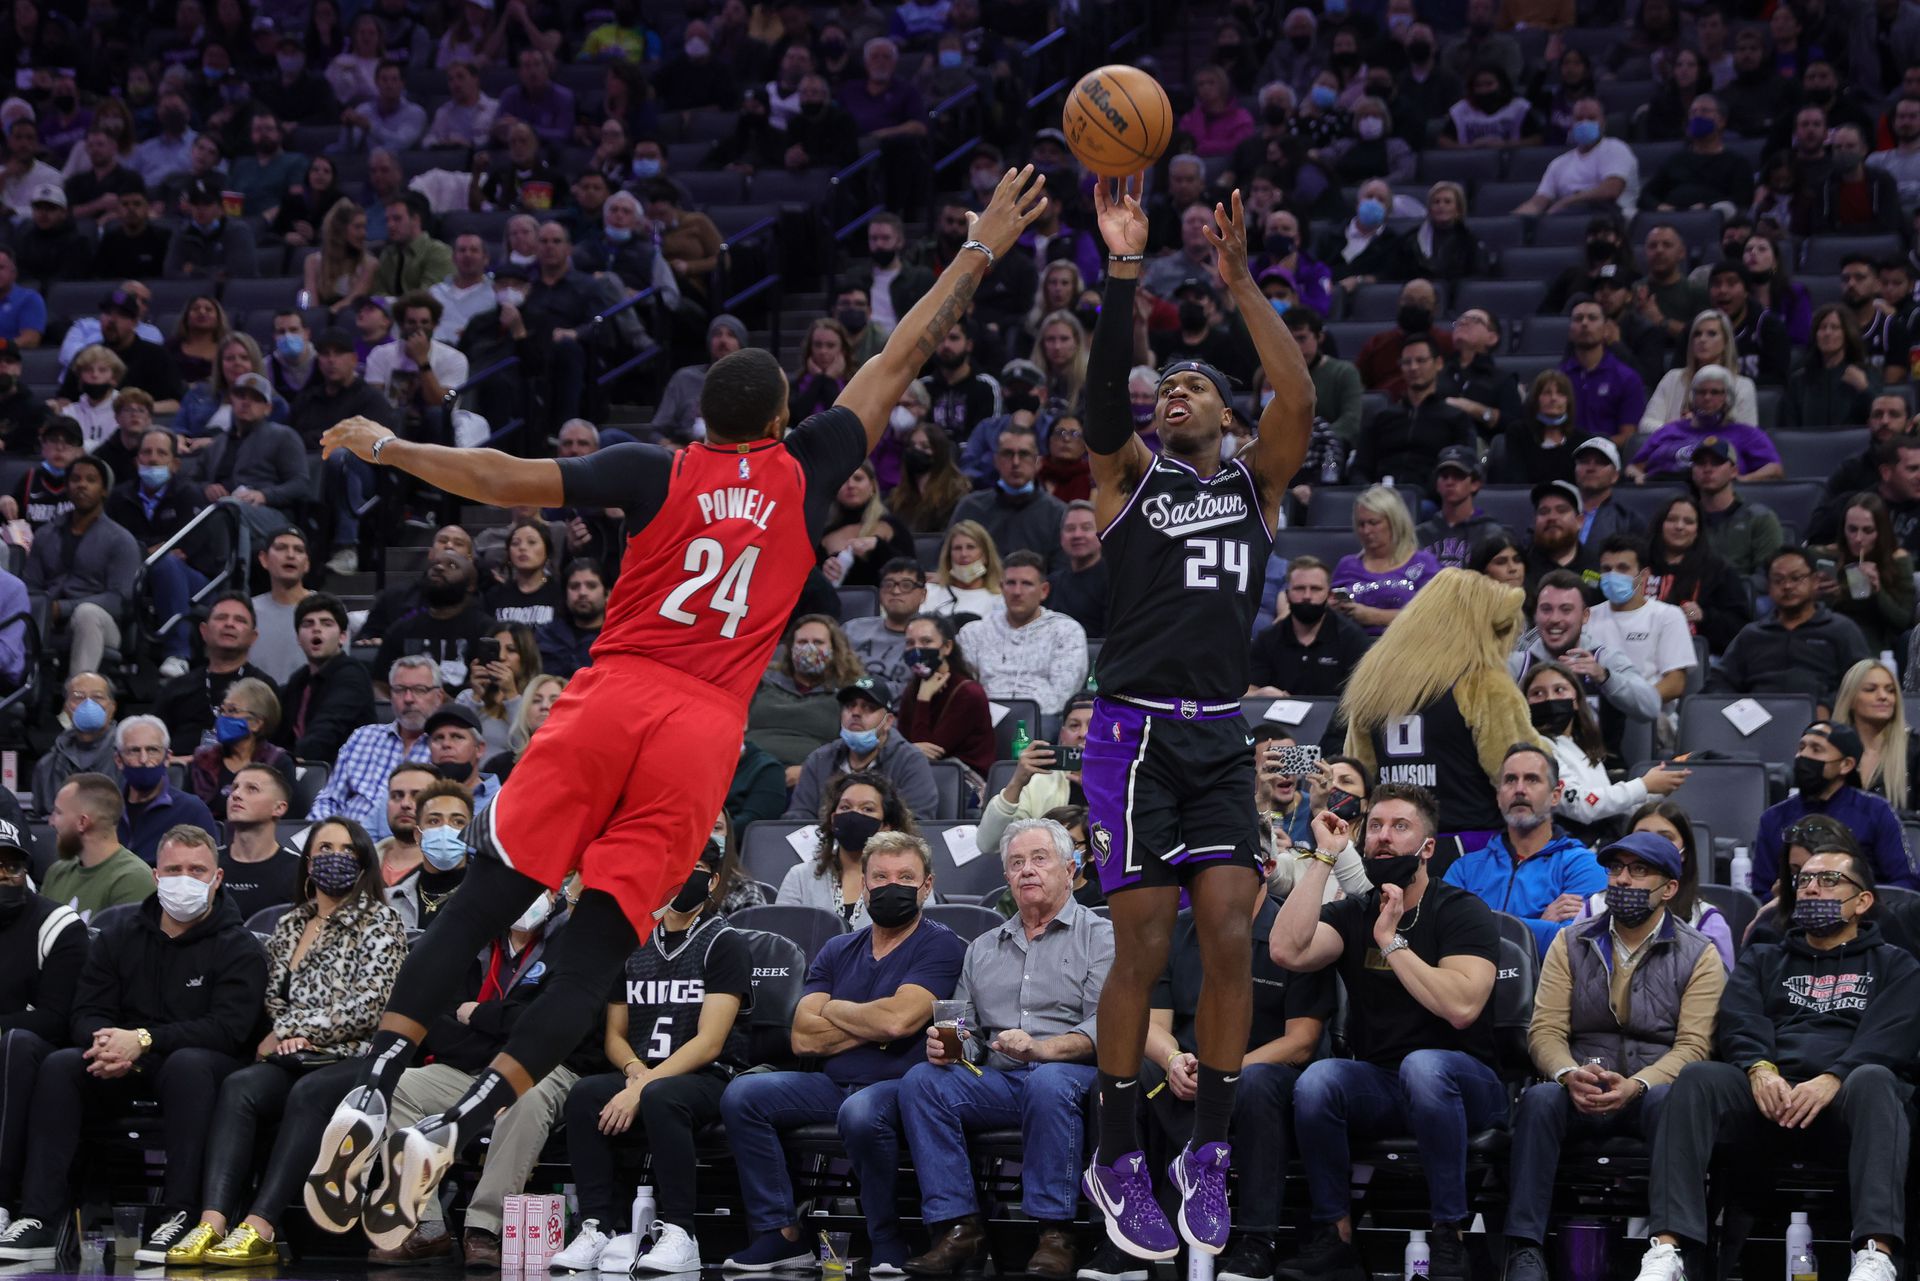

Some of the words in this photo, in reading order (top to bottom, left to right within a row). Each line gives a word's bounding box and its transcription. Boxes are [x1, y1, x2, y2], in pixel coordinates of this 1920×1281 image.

[1081, 77, 1129, 135] Wilson
[1210, 469, 1241, 486] dialpad
[697, 487, 776, 530] POWELL
[1141, 490, 1248, 533] Sactown
[1184, 538, 1250, 594] 24
[658, 537, 761, 639] 24
[1384, 713, 1425, 757] 0
[1379, 763, 1437, 787] SLAMSON
[626, 979, 705, 1005] KINGS
[751, 967, 789, 977] REEK
[1496, 967, 1520, 980] EK
[647, 1016, 673, 1059] 5
